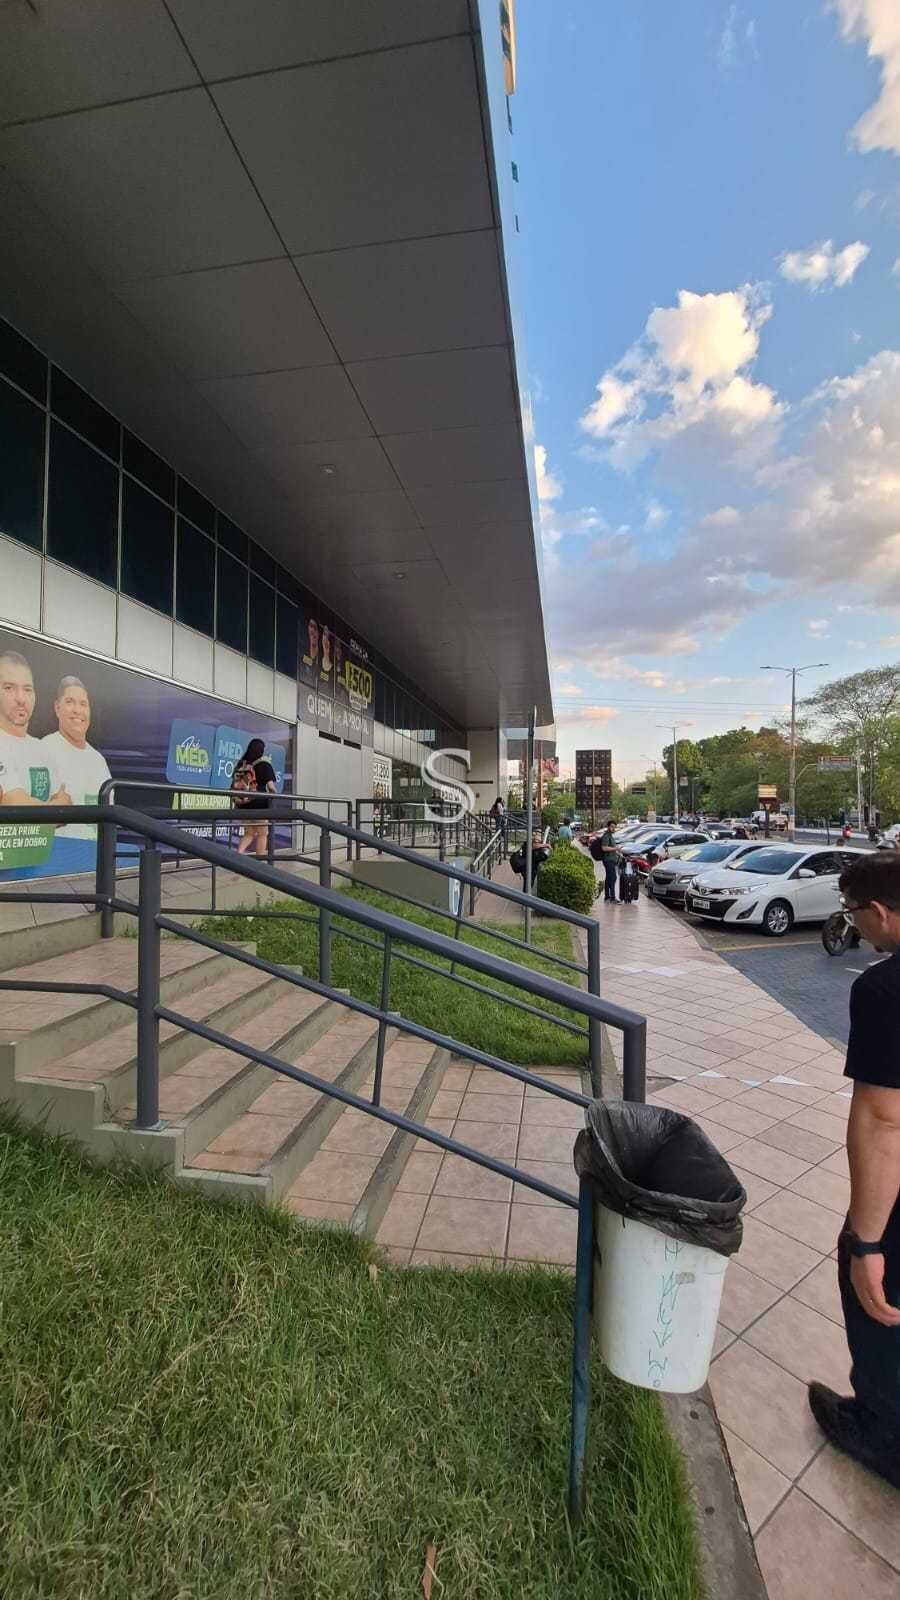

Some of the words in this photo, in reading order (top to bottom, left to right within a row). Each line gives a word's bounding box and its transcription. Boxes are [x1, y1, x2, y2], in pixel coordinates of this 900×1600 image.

[176, 744, 209, 767] MED
[218, 740, 243, 760] MED
[18, 825, 41, 836] PRIME
[0, 839, 11, 849] CA
[12, 838, 23, 849] EM
[24, 837, 48, 848] DOBRO
